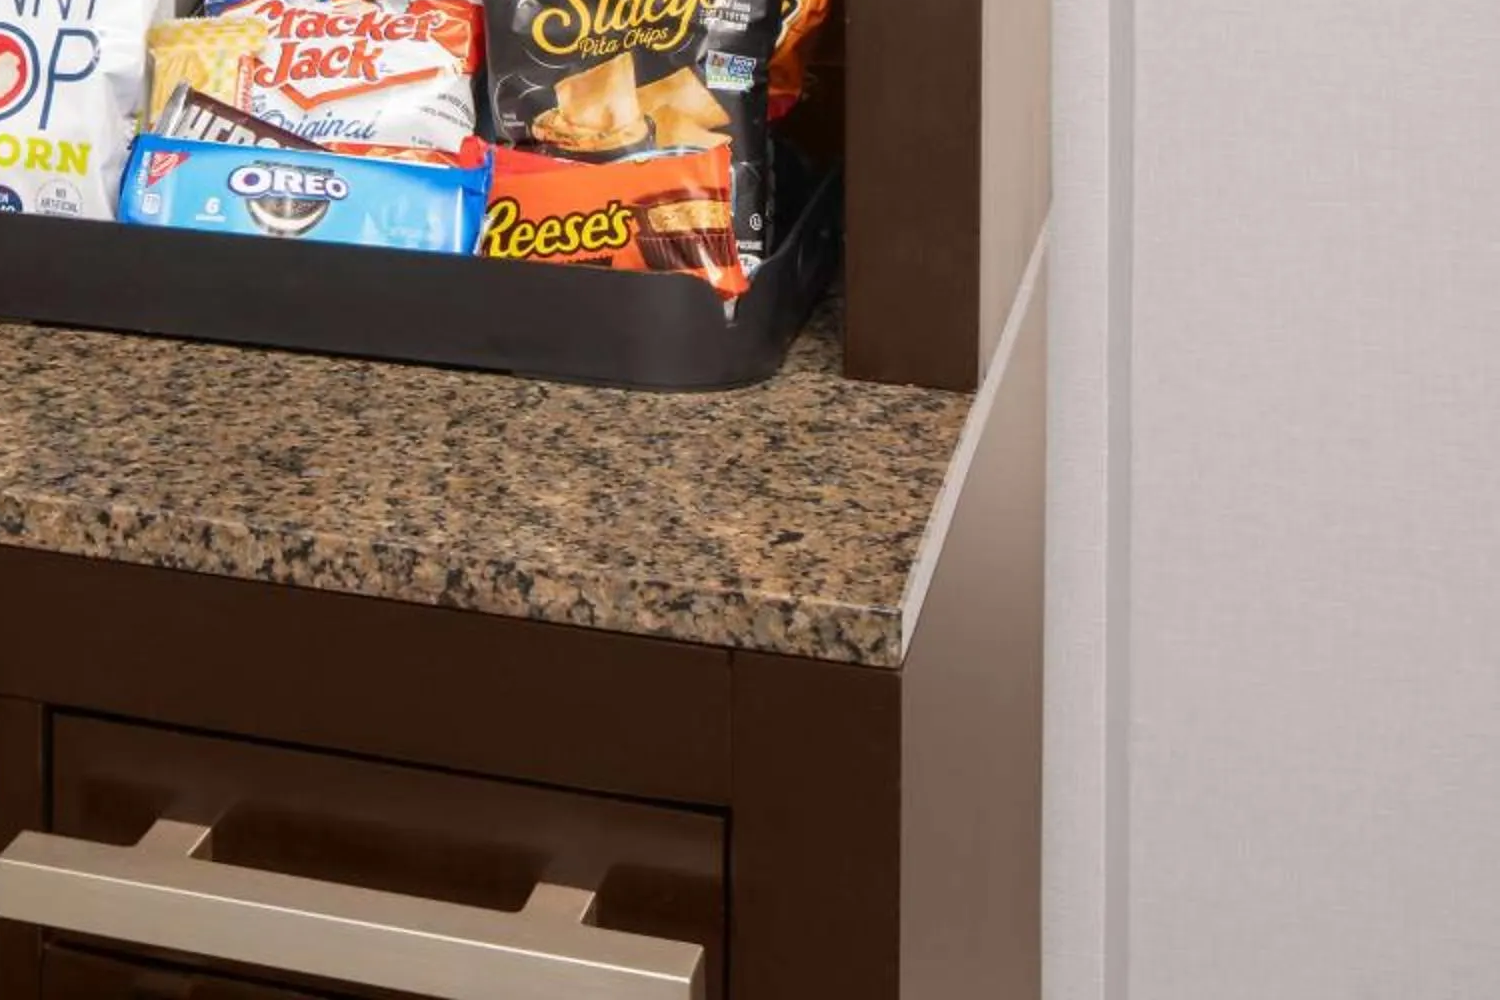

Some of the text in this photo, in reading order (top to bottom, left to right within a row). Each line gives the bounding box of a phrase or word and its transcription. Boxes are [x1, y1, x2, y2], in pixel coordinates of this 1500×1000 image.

[579, 26, 669, 59] Pita Chips
[254, 39, 383, 88] Jack
[229, 165, 348, 200] OREO
[204, 196, 221, 214] 6
[484, 199, 631, 258] Reese's
